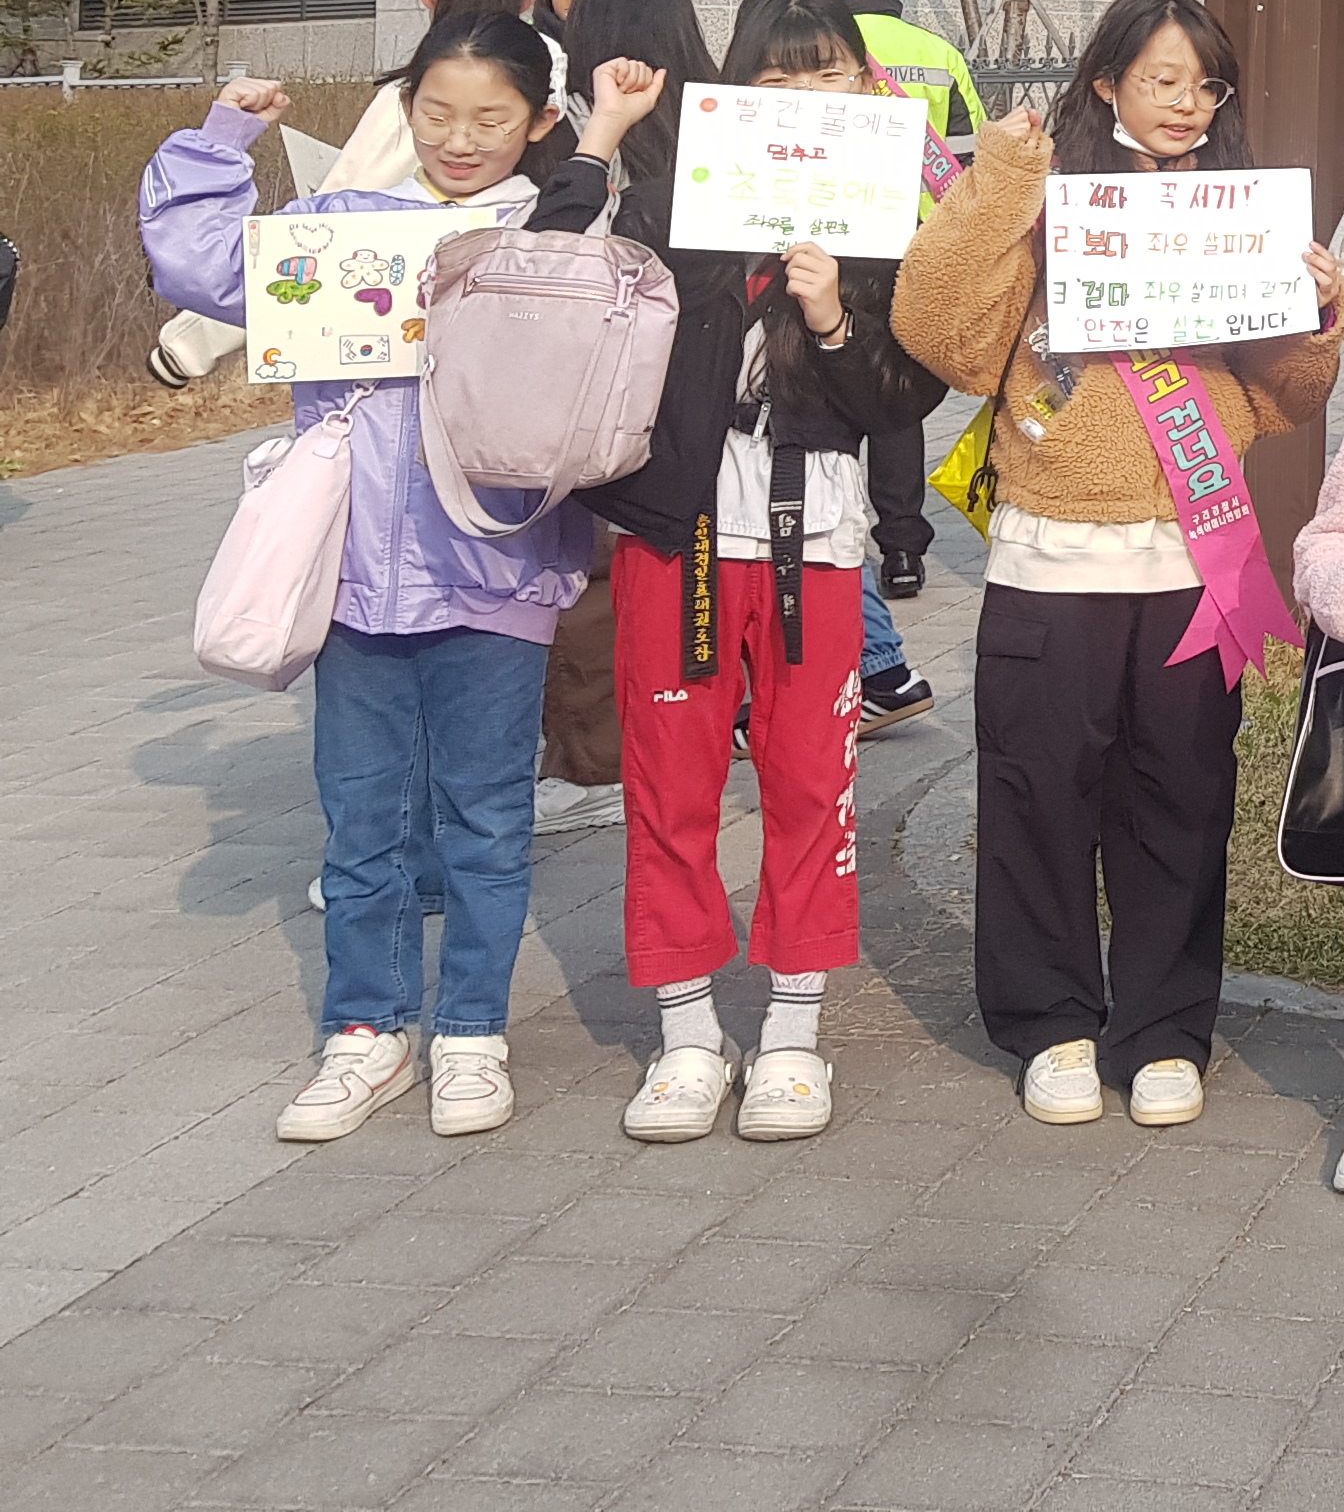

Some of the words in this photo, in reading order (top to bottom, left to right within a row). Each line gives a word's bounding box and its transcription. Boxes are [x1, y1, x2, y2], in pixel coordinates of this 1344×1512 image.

[885, 67, 926, 83] RIVER
[767, 143, 828, 162] 멈추고
[1160, 182, 1178, 209] 꼭
[743, 214, 795, 236] 좌우를
[1147, 232, 1188, 256] 좌우
[1144, 281, 1180, 303] 좌우
[1191, 281, 1247, 303] 살피며
[1157, 398, 1231, 503] 건너요
[653, 689, 689, 703] FILA
